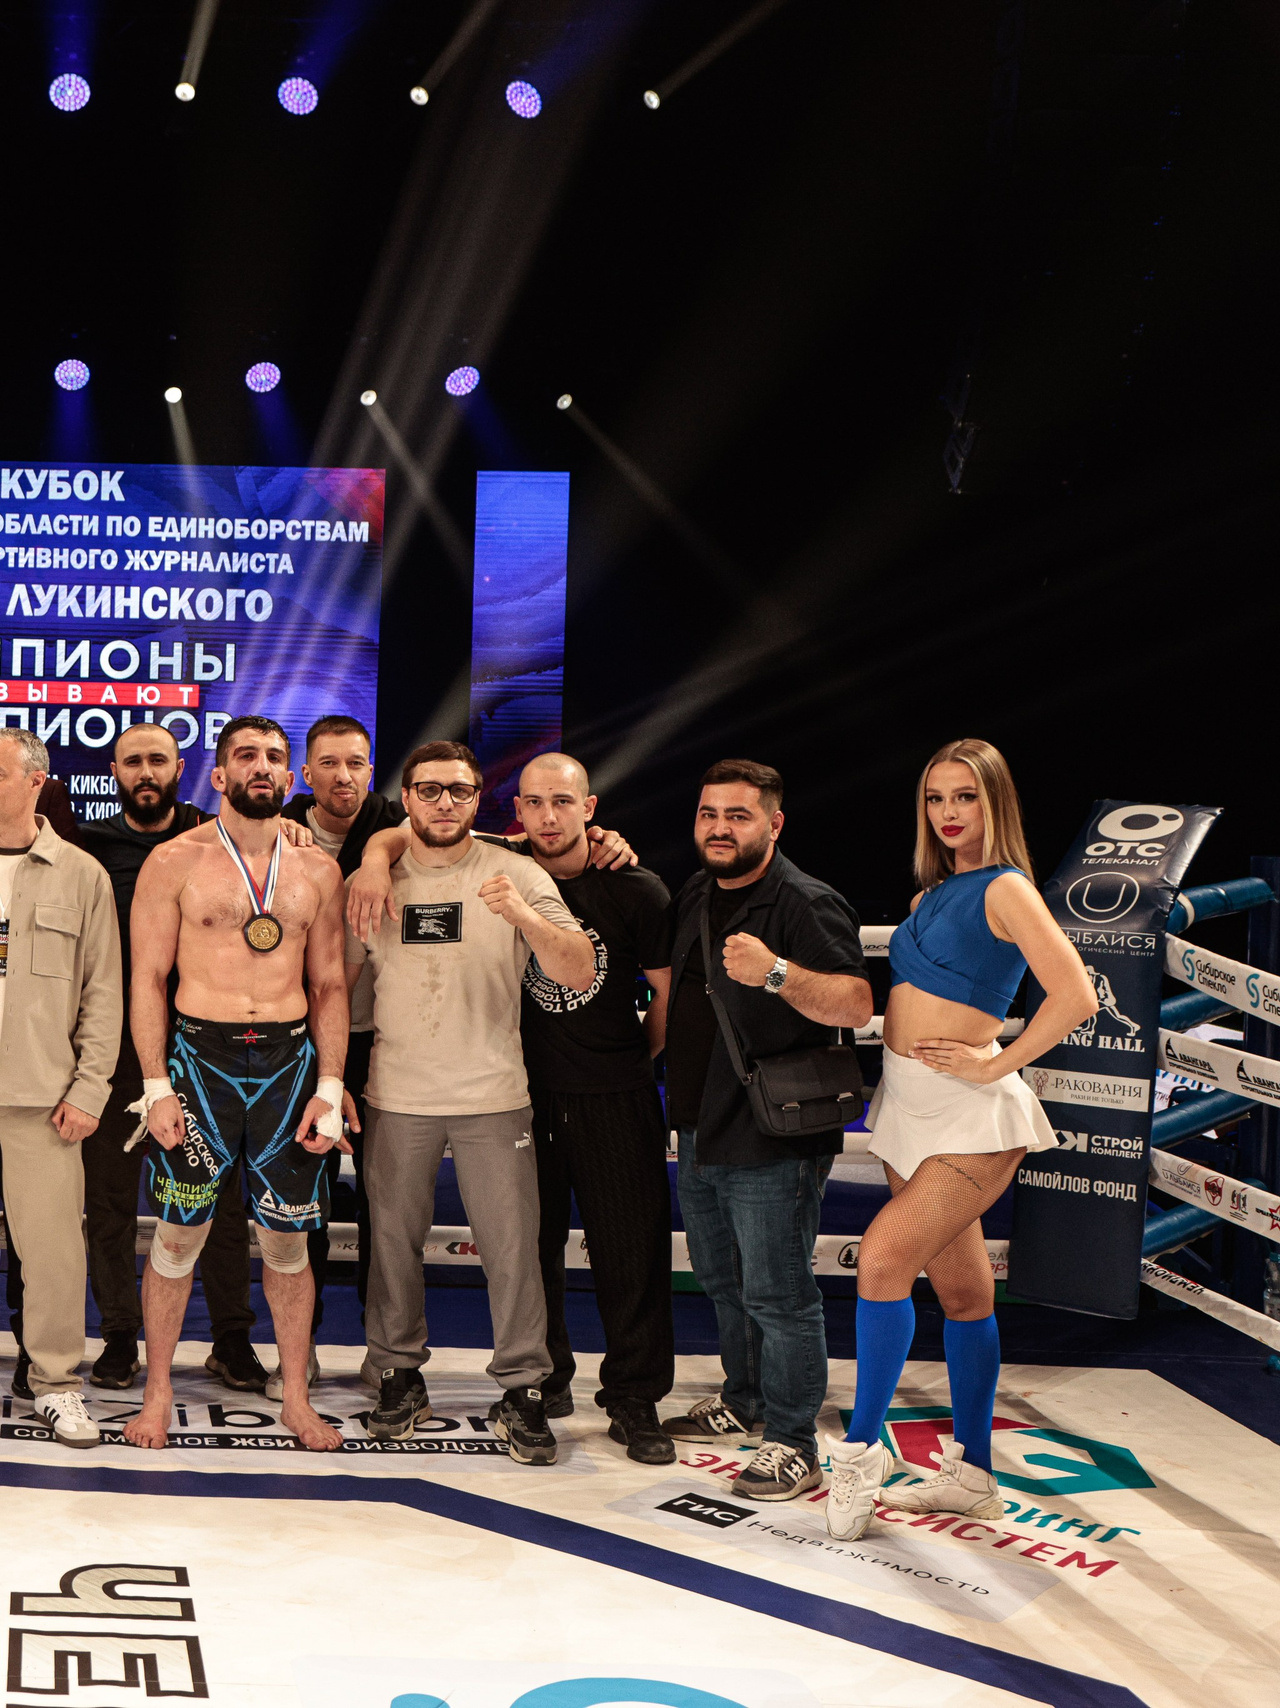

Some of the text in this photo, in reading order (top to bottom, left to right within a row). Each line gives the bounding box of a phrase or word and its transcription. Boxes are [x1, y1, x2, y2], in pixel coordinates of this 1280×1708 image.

[0, 468, 125, 501] КУБОК
[106, 516, 141, 537] ПО
[148, 516, 369, 543] ЕДИНОБОРСТВАМ
[124, 550, 294, 574] ЖУРНАЛИСТА
[6, 583, 273, 622] ЛУКИНСКОГО
[70, 775, 118, 796] КИКБО
[1081, 857, 1160, 867] ТЕЛЕКАНАЛ
[1066, 931, 1156, 950] ЫБАЙСЯ
[1078, 946, 1125, 955] ОГИЧЕСКИЙ
[1195, 959, 1236, 985] Сибирское
[1197, 973, 1227, 994] Стекло
[1058, 1032, 1146, 1053] ING HALL
[1178, 1053, 1216, 1074] АВАНГАРД
[1054, 1077, 1143, 1098] РАКОВАРНЯ
[1090, 1146, 1143, 1160] КОМПЛЕКТ
[1091, 1135, 1144, 1151] СТРОЙ
[1018, 1168, 1137, 1202] САМОЙЛОВ ФОНД
[230, 1437, 296, 1448] ЖБИ
[671, 1498, 743, 1523] ГИС
[747, 1520, 992, 1595] Недвижимость
